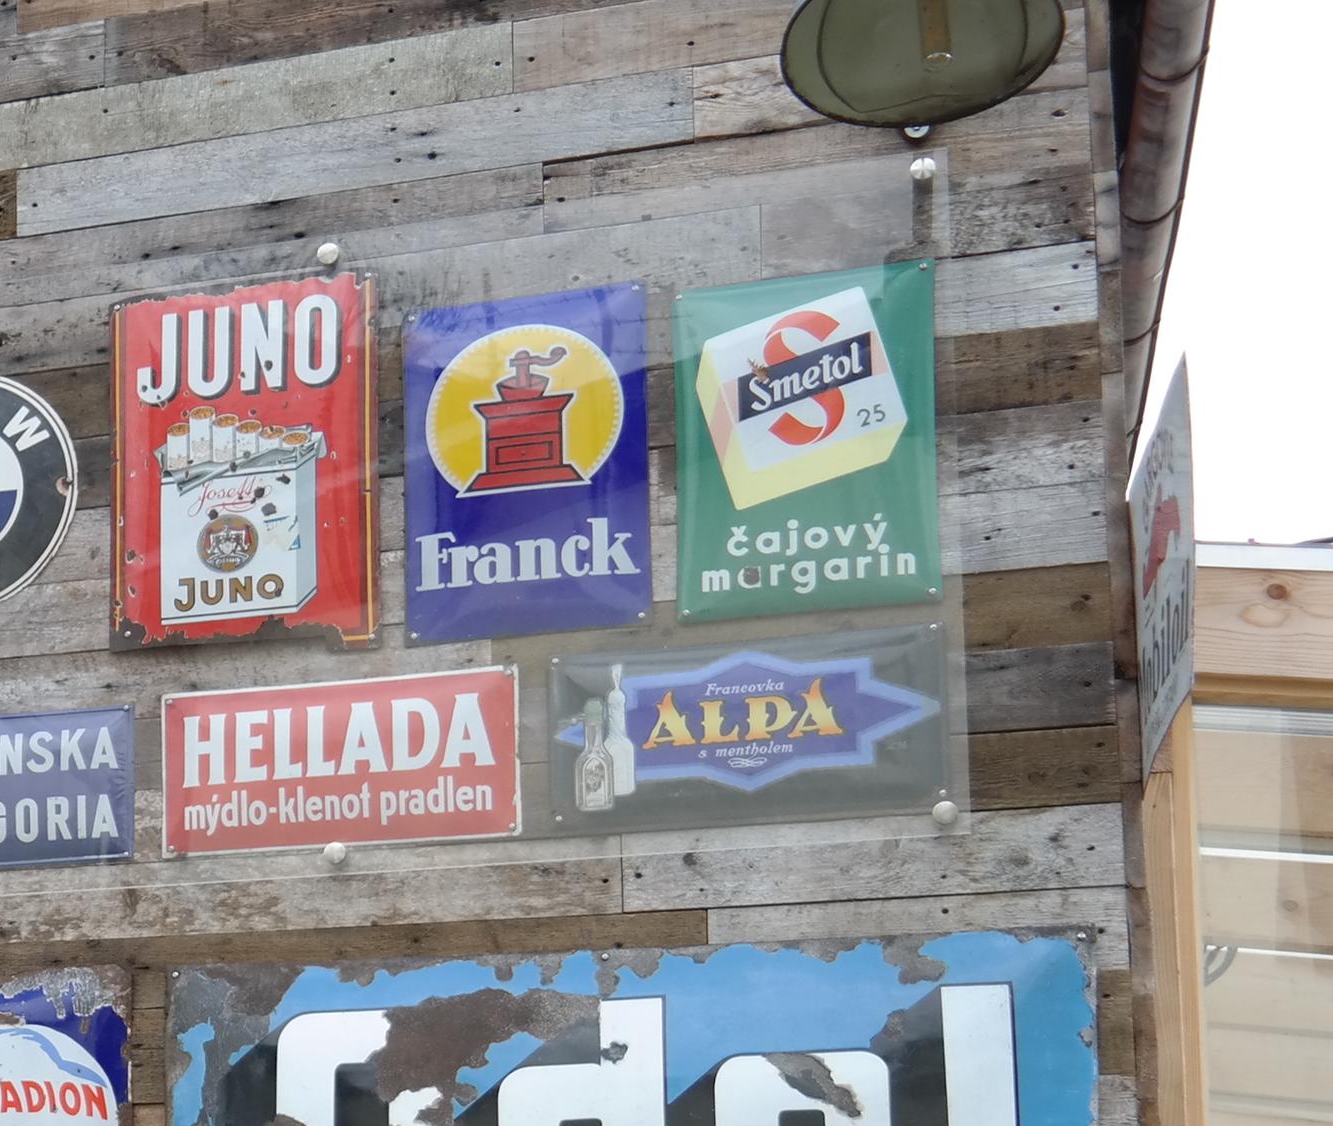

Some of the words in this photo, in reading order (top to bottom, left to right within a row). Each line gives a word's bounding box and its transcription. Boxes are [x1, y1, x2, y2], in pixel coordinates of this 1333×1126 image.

[136, 295, 339, 404] JUNO
[749, 342, 864, 411] Smetol
[857, 404, 887, 428] 25
[415, 518, 641, 592] Franck
[727, 513, 887, 556] čajový
[174, 574, 284, 613] JUNO
[702, 544, 917, 594] margarin
[643, 678, 844, 749] ALPA
[705, 680, 785, 696] Francovka
[183, 692, 496, 788] HELLADA
[715, 741, 793, 758] mentholem
[184, 781, 370, 836] mýdlo-klenot
[379, 776, 493, 826] pradlen
